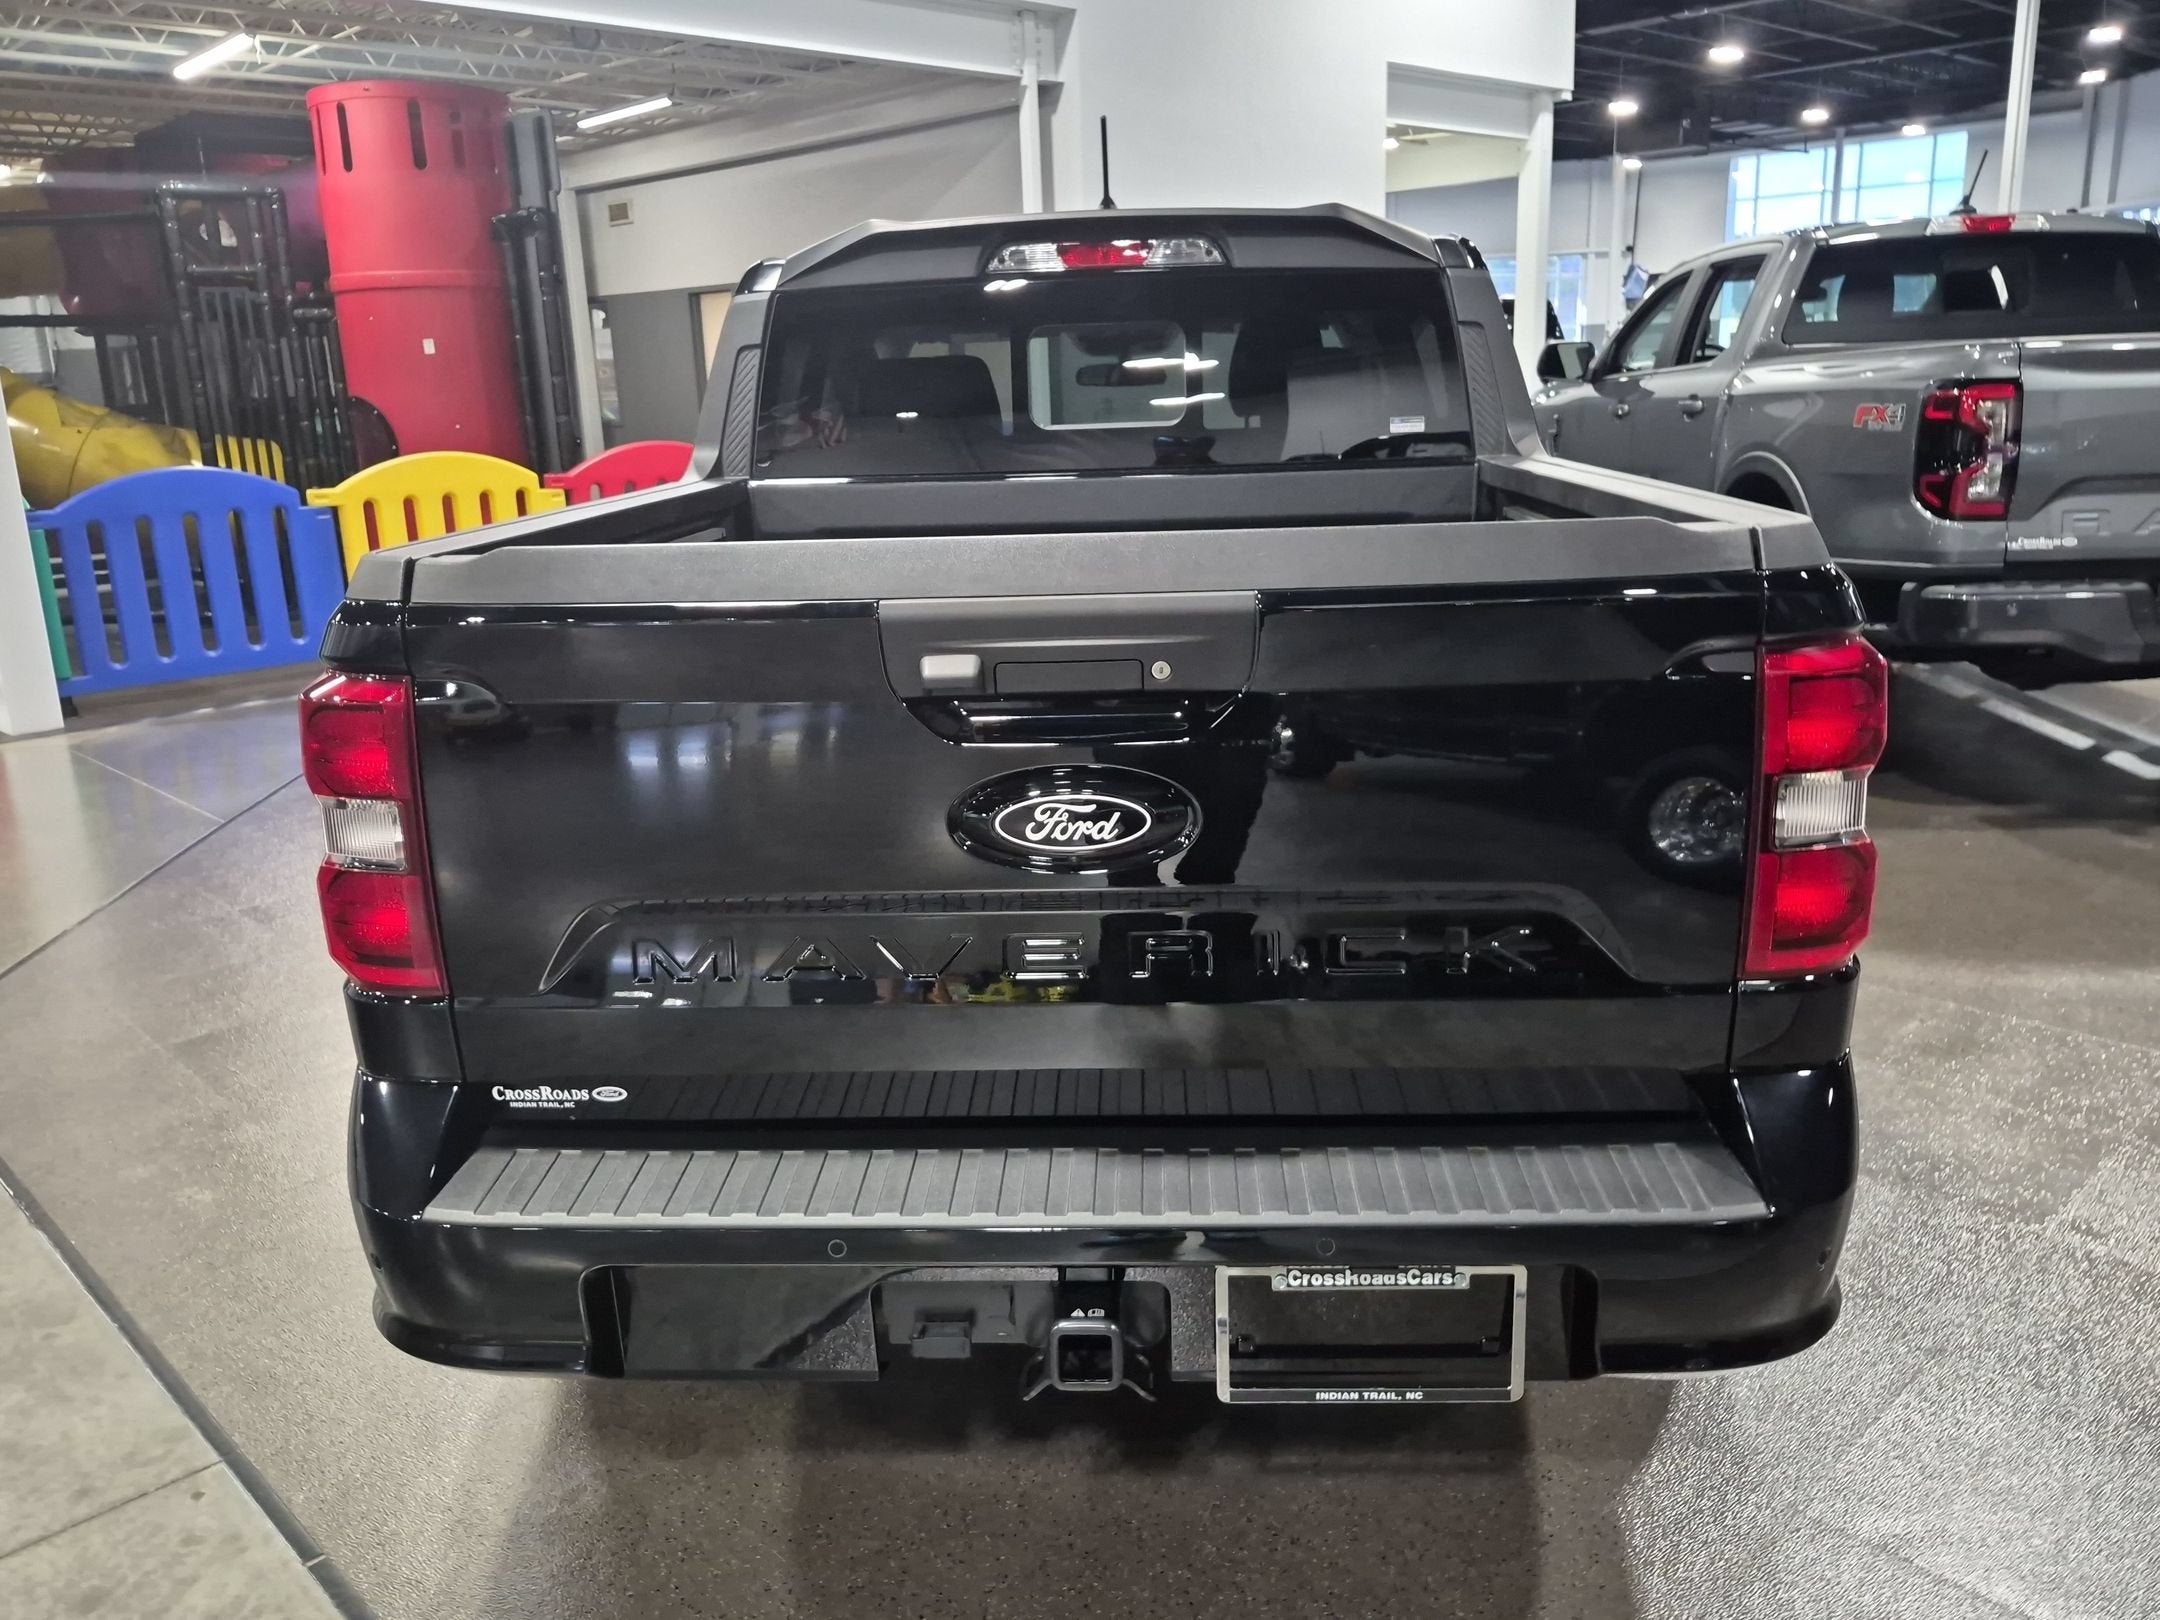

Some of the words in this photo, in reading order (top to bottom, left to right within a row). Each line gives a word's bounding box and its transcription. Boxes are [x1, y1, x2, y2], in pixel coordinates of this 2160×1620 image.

[1025, 802, 1120, 841] Ford
[631, 926, 1537, 985] MAVERICK
[1315, 1391, 1359, 1401] INDIAN
[1362, 1391, 1402, 1401] TRAIL,
[1405, 1391, 1424, 1400] NC
